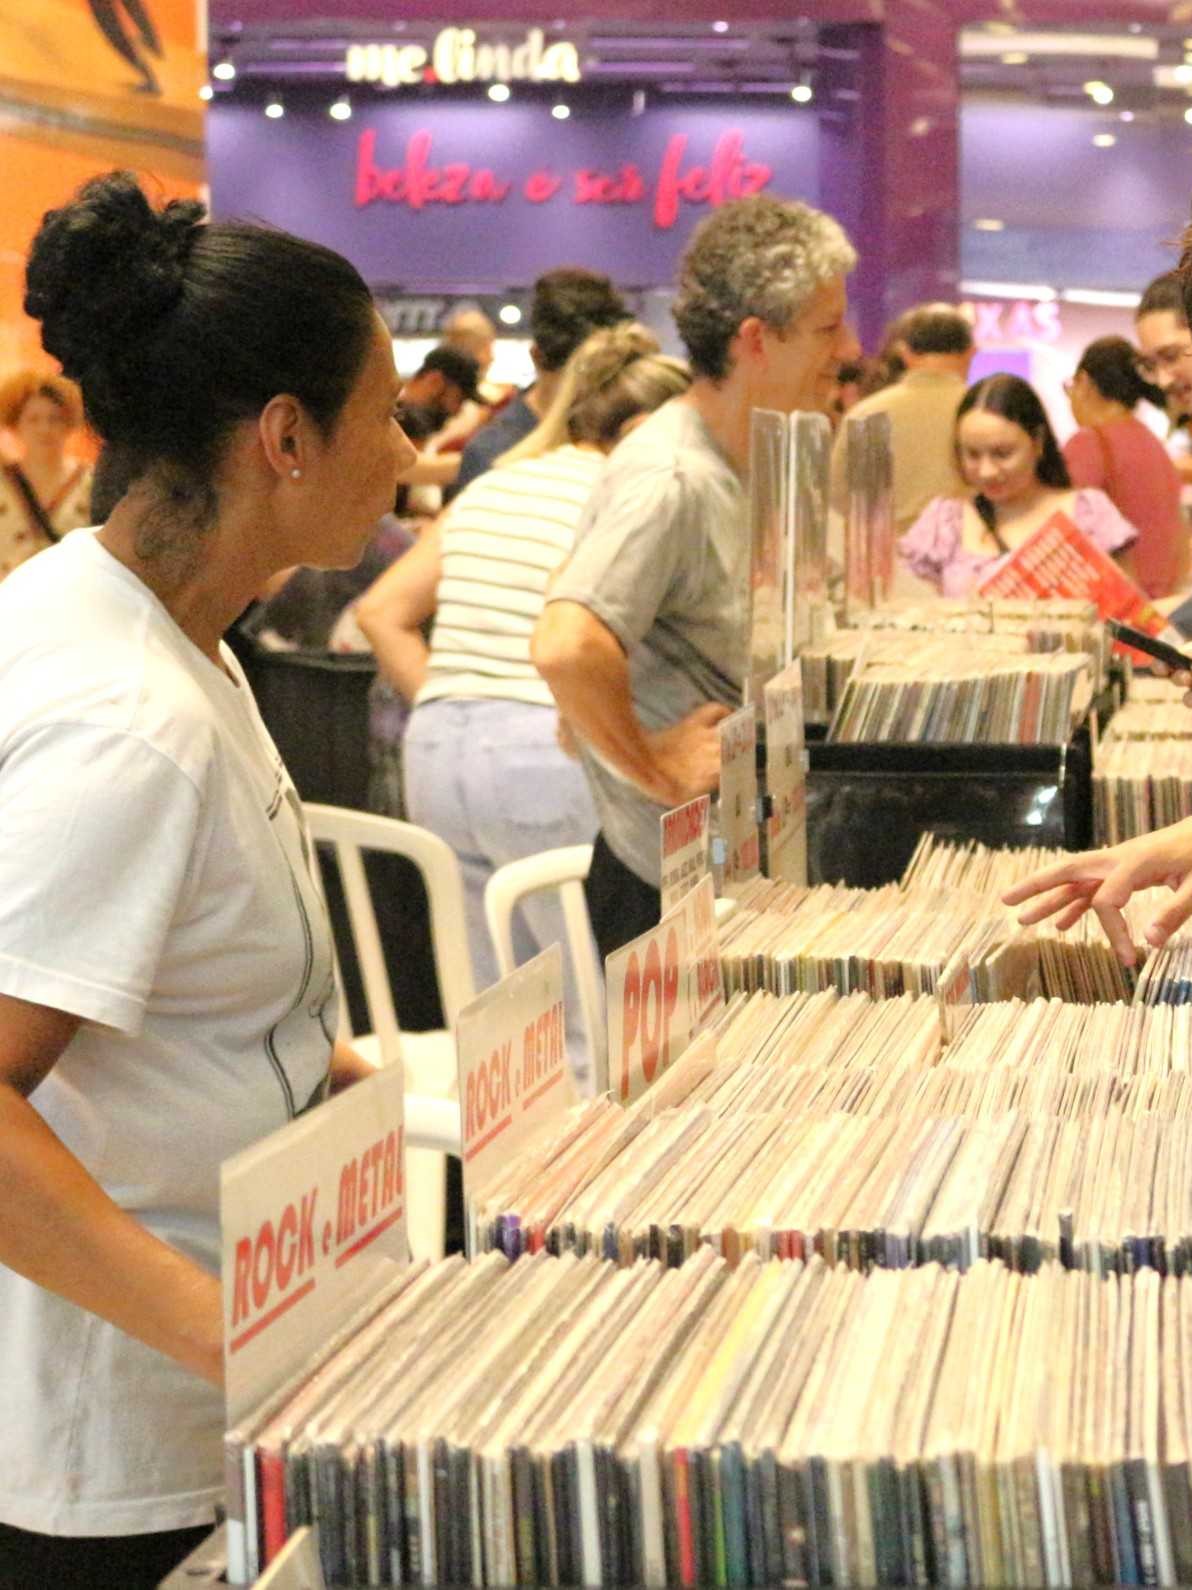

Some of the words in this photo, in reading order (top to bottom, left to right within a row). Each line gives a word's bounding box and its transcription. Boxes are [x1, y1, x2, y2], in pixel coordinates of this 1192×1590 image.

[620, 926, 680, 1102] POP
[465, 1037, 513, 1144] ROCK
[232, 1186, 319, 1328] ROCK
[321, 1219, 332, 1257] e
